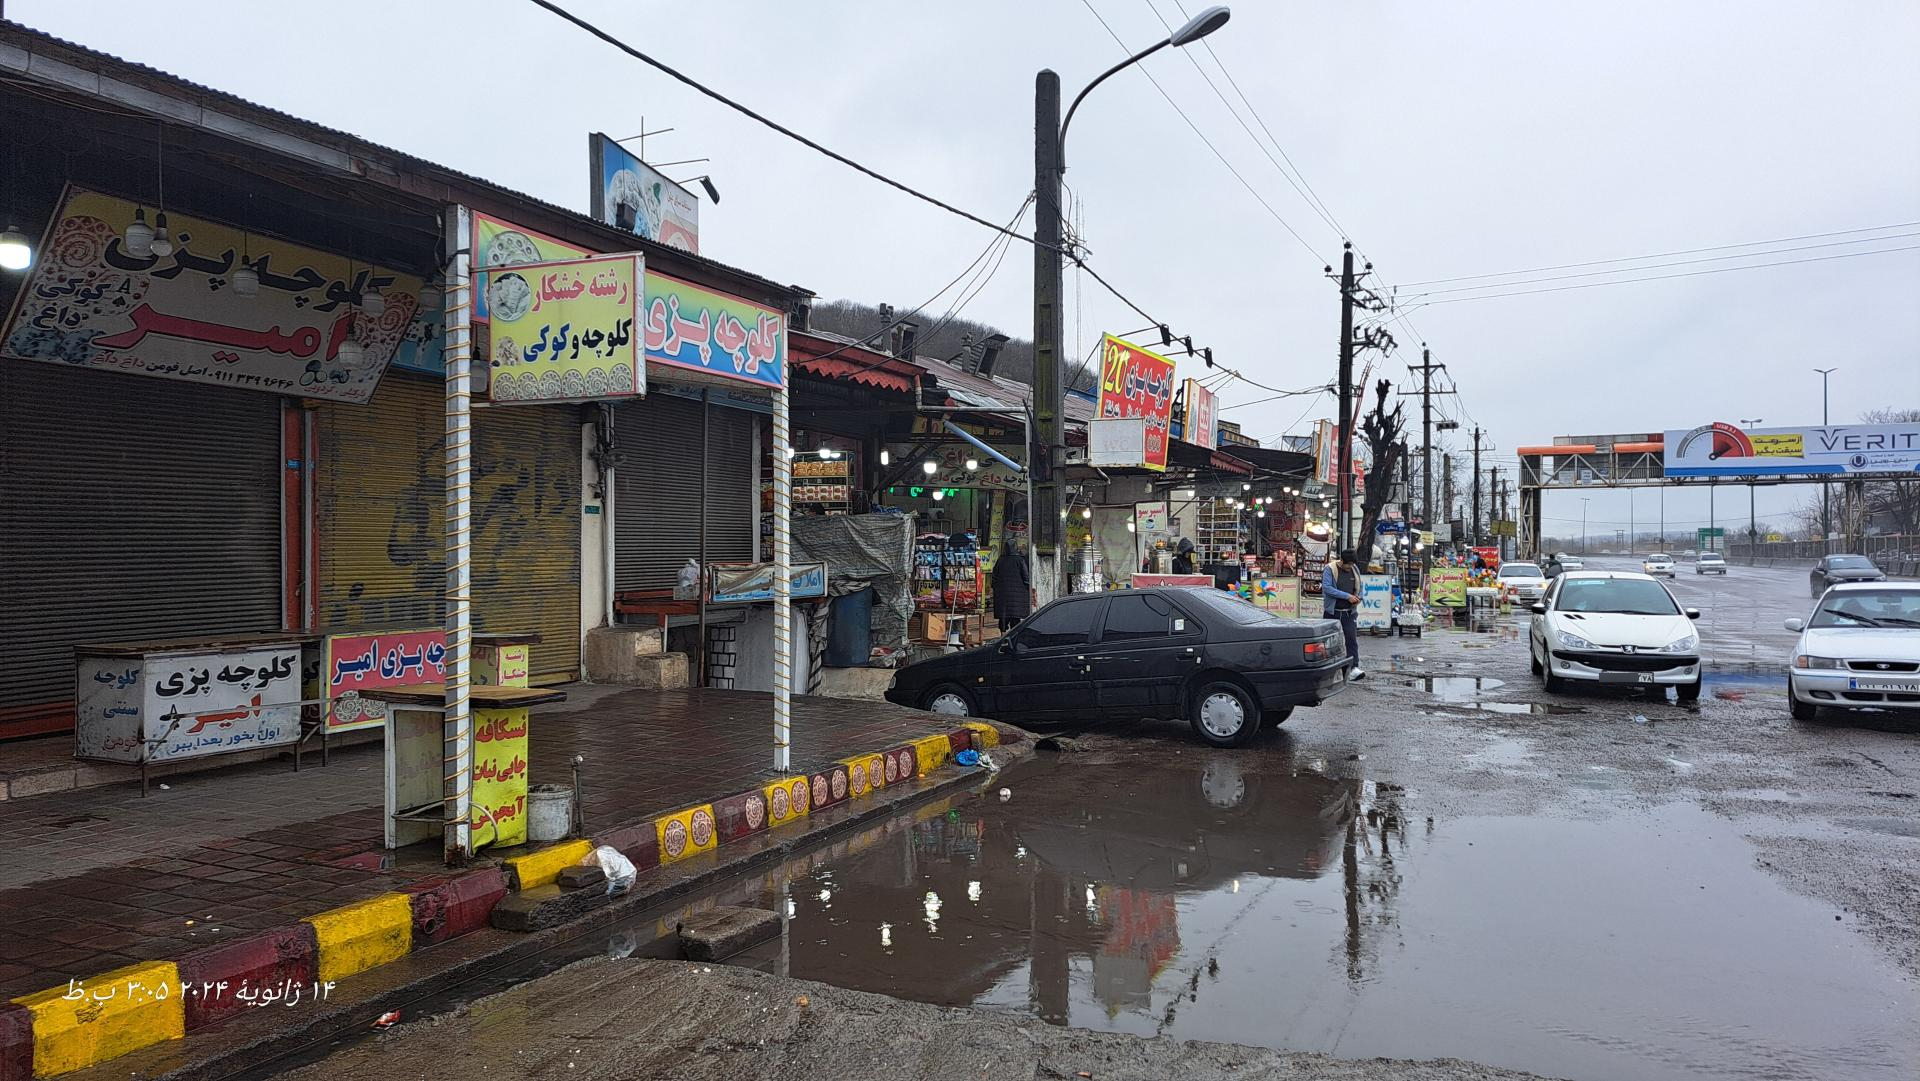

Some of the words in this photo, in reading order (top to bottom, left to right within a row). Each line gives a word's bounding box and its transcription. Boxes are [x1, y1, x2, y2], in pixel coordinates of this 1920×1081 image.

[37, 278, 112, 304] کوکی
[531, 271, 586, 312] خشکار
[589, 268, 627, 304] رشته
[32, 302, 81, 329] داغ
[91, 302, 358, 364] امیر
[645, 293, 711, 366] پزی
[523, 323, 571, 362] کوکی
[582, 318, 633, 358] کلوچه
[714, 310, 780, 374] کلوچه
[145, 360, 178, 374] فومن
[1104, 344, 1130, 395] 20
[1811, 429, 1919, 450] VERIT
[1003, 473, 1028, 487] لوچه
[1362, 599, 1381, 609] WC
[94, 668, 140, 689] کلوچه
[217, 655, 297, 692] کلوچه
[331, 639, 379, 686] امیر
[380, 642, 424, 680] پزی
[155, 667, 211, 697] پزی
[103, 700, 139, 718] سنتی
[186, 693, 262, 734] امیر
[226, 731, 254, 746] بخور
[496, 755, 527, 782] چایی
